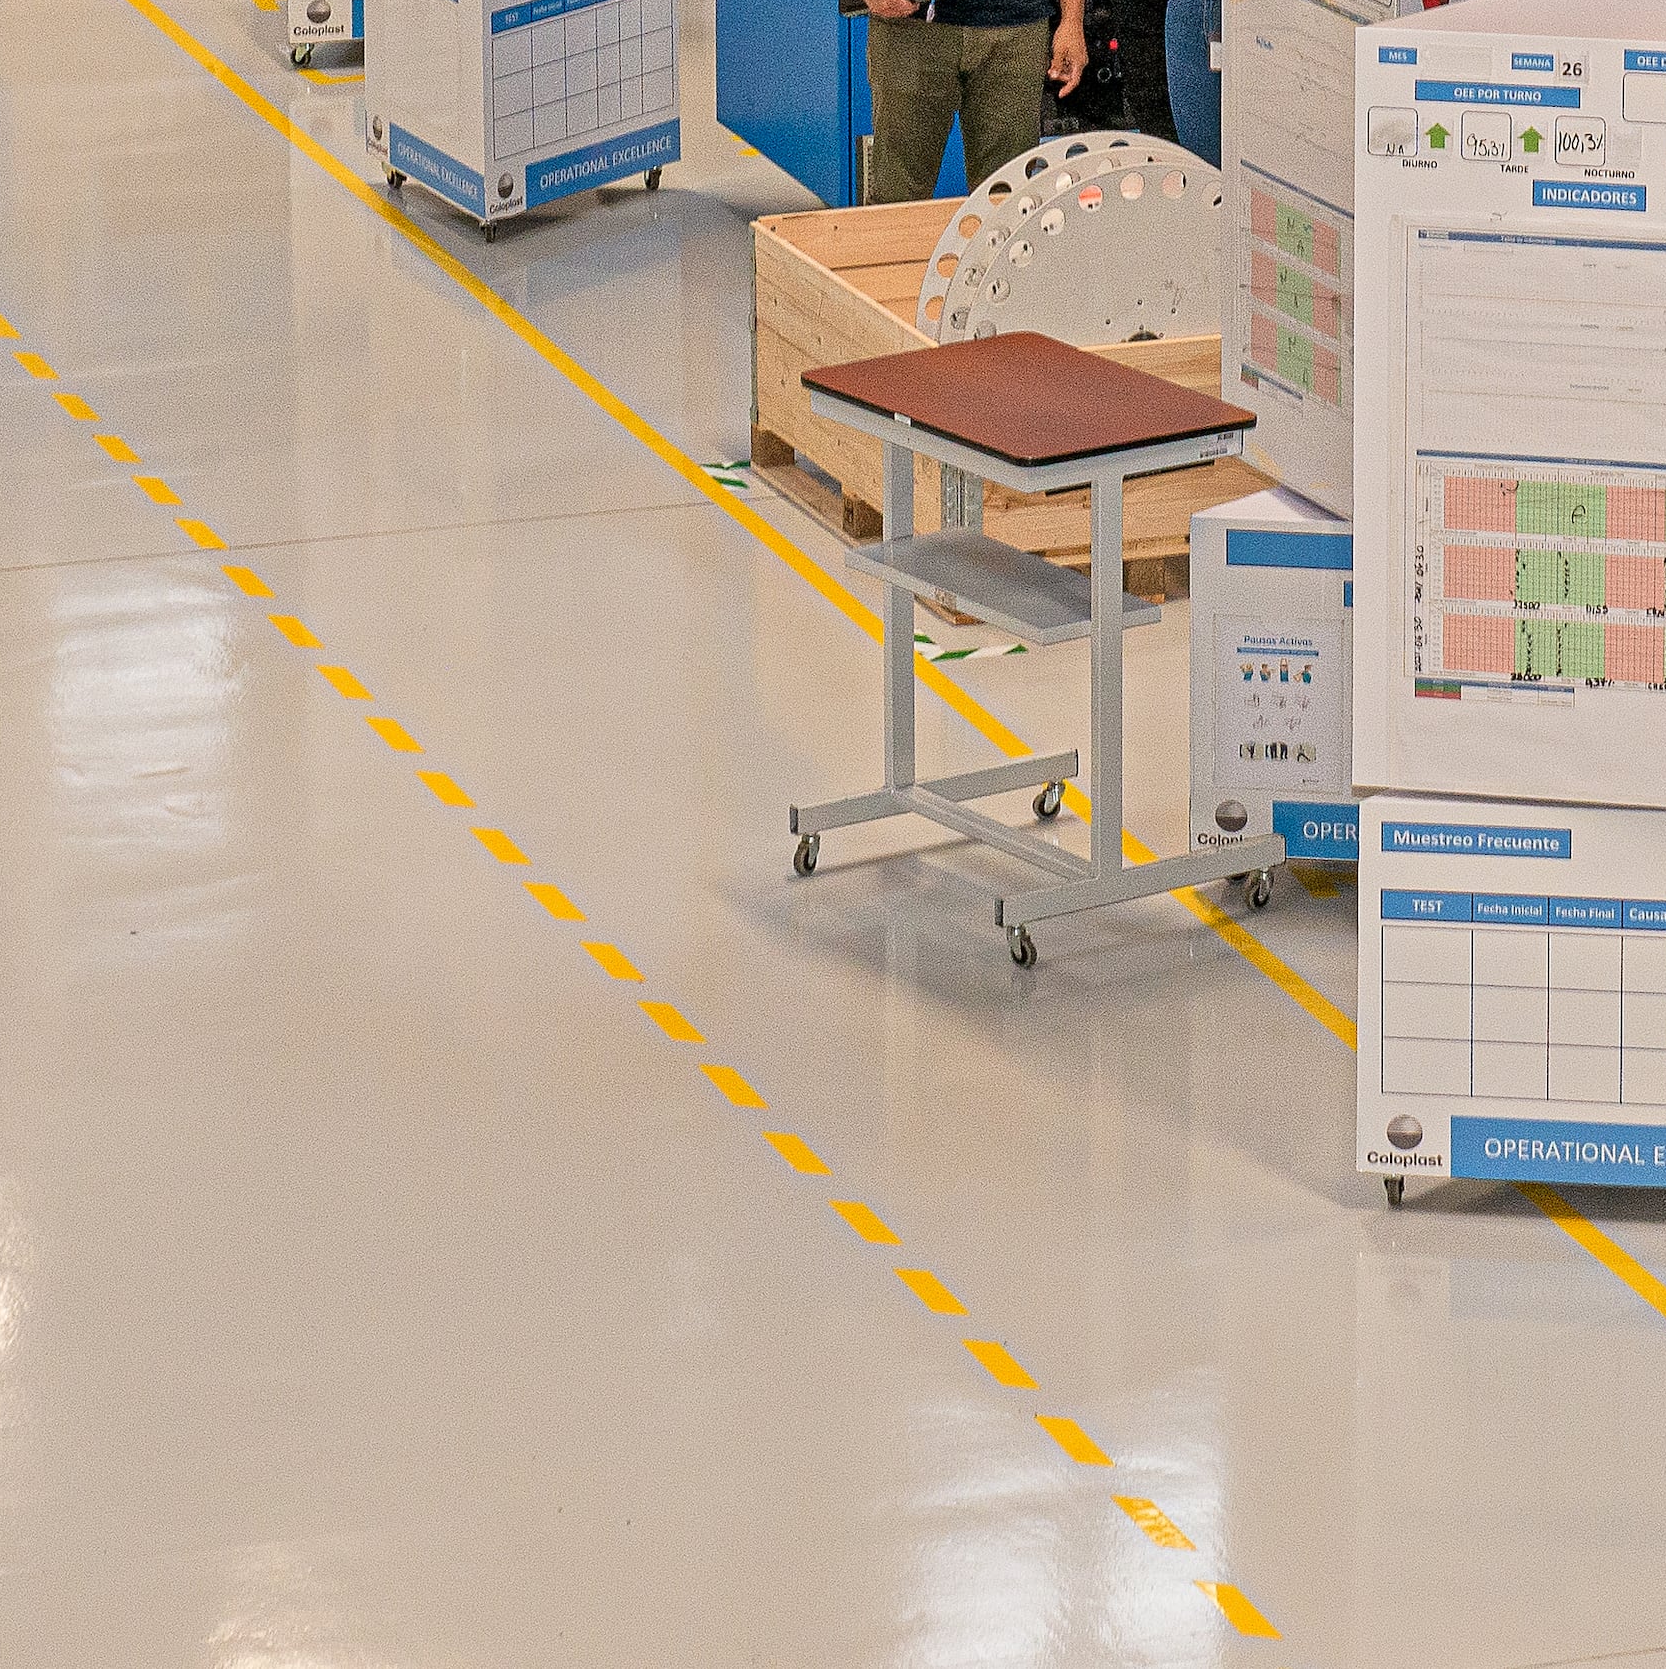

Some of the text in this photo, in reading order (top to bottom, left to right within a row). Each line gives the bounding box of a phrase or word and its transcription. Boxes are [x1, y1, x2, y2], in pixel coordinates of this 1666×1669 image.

[294, 24, 345, 37] Coloplast
[1388, 51, 1407, 61] MES
[1637, 56, 1659, 67] OEE
[1513, 57, 1582, 77] SEMANA 26
[1453, 87, 1542, 101] OEE POR TURNO
[540, 134, 672, 190] OPERATIONAL EXCELLENCE
[1402, 159, 1635, 179] DIURNO TARDE NOCTURNO
[489, 196, 524, 214] Coloplast
[1542, 188, 1638, 206] INDICADORES
[1244, 634, 1313, 647] Pausas Activas
[1303, 820, 1357, 840] OPER
[1393, 829, 1560, 852] Muestreo Frecuente
[1412, 899, 1443, 914] TEST
[1477, 902, 1542, 917] Fecha Inicial
[1555, 905, 1614, 920] Fecha Final
[1367, 1150, 1443, 1169] Coloplast
[1484, 1137, 1646, 1165] OPERATIONAL
